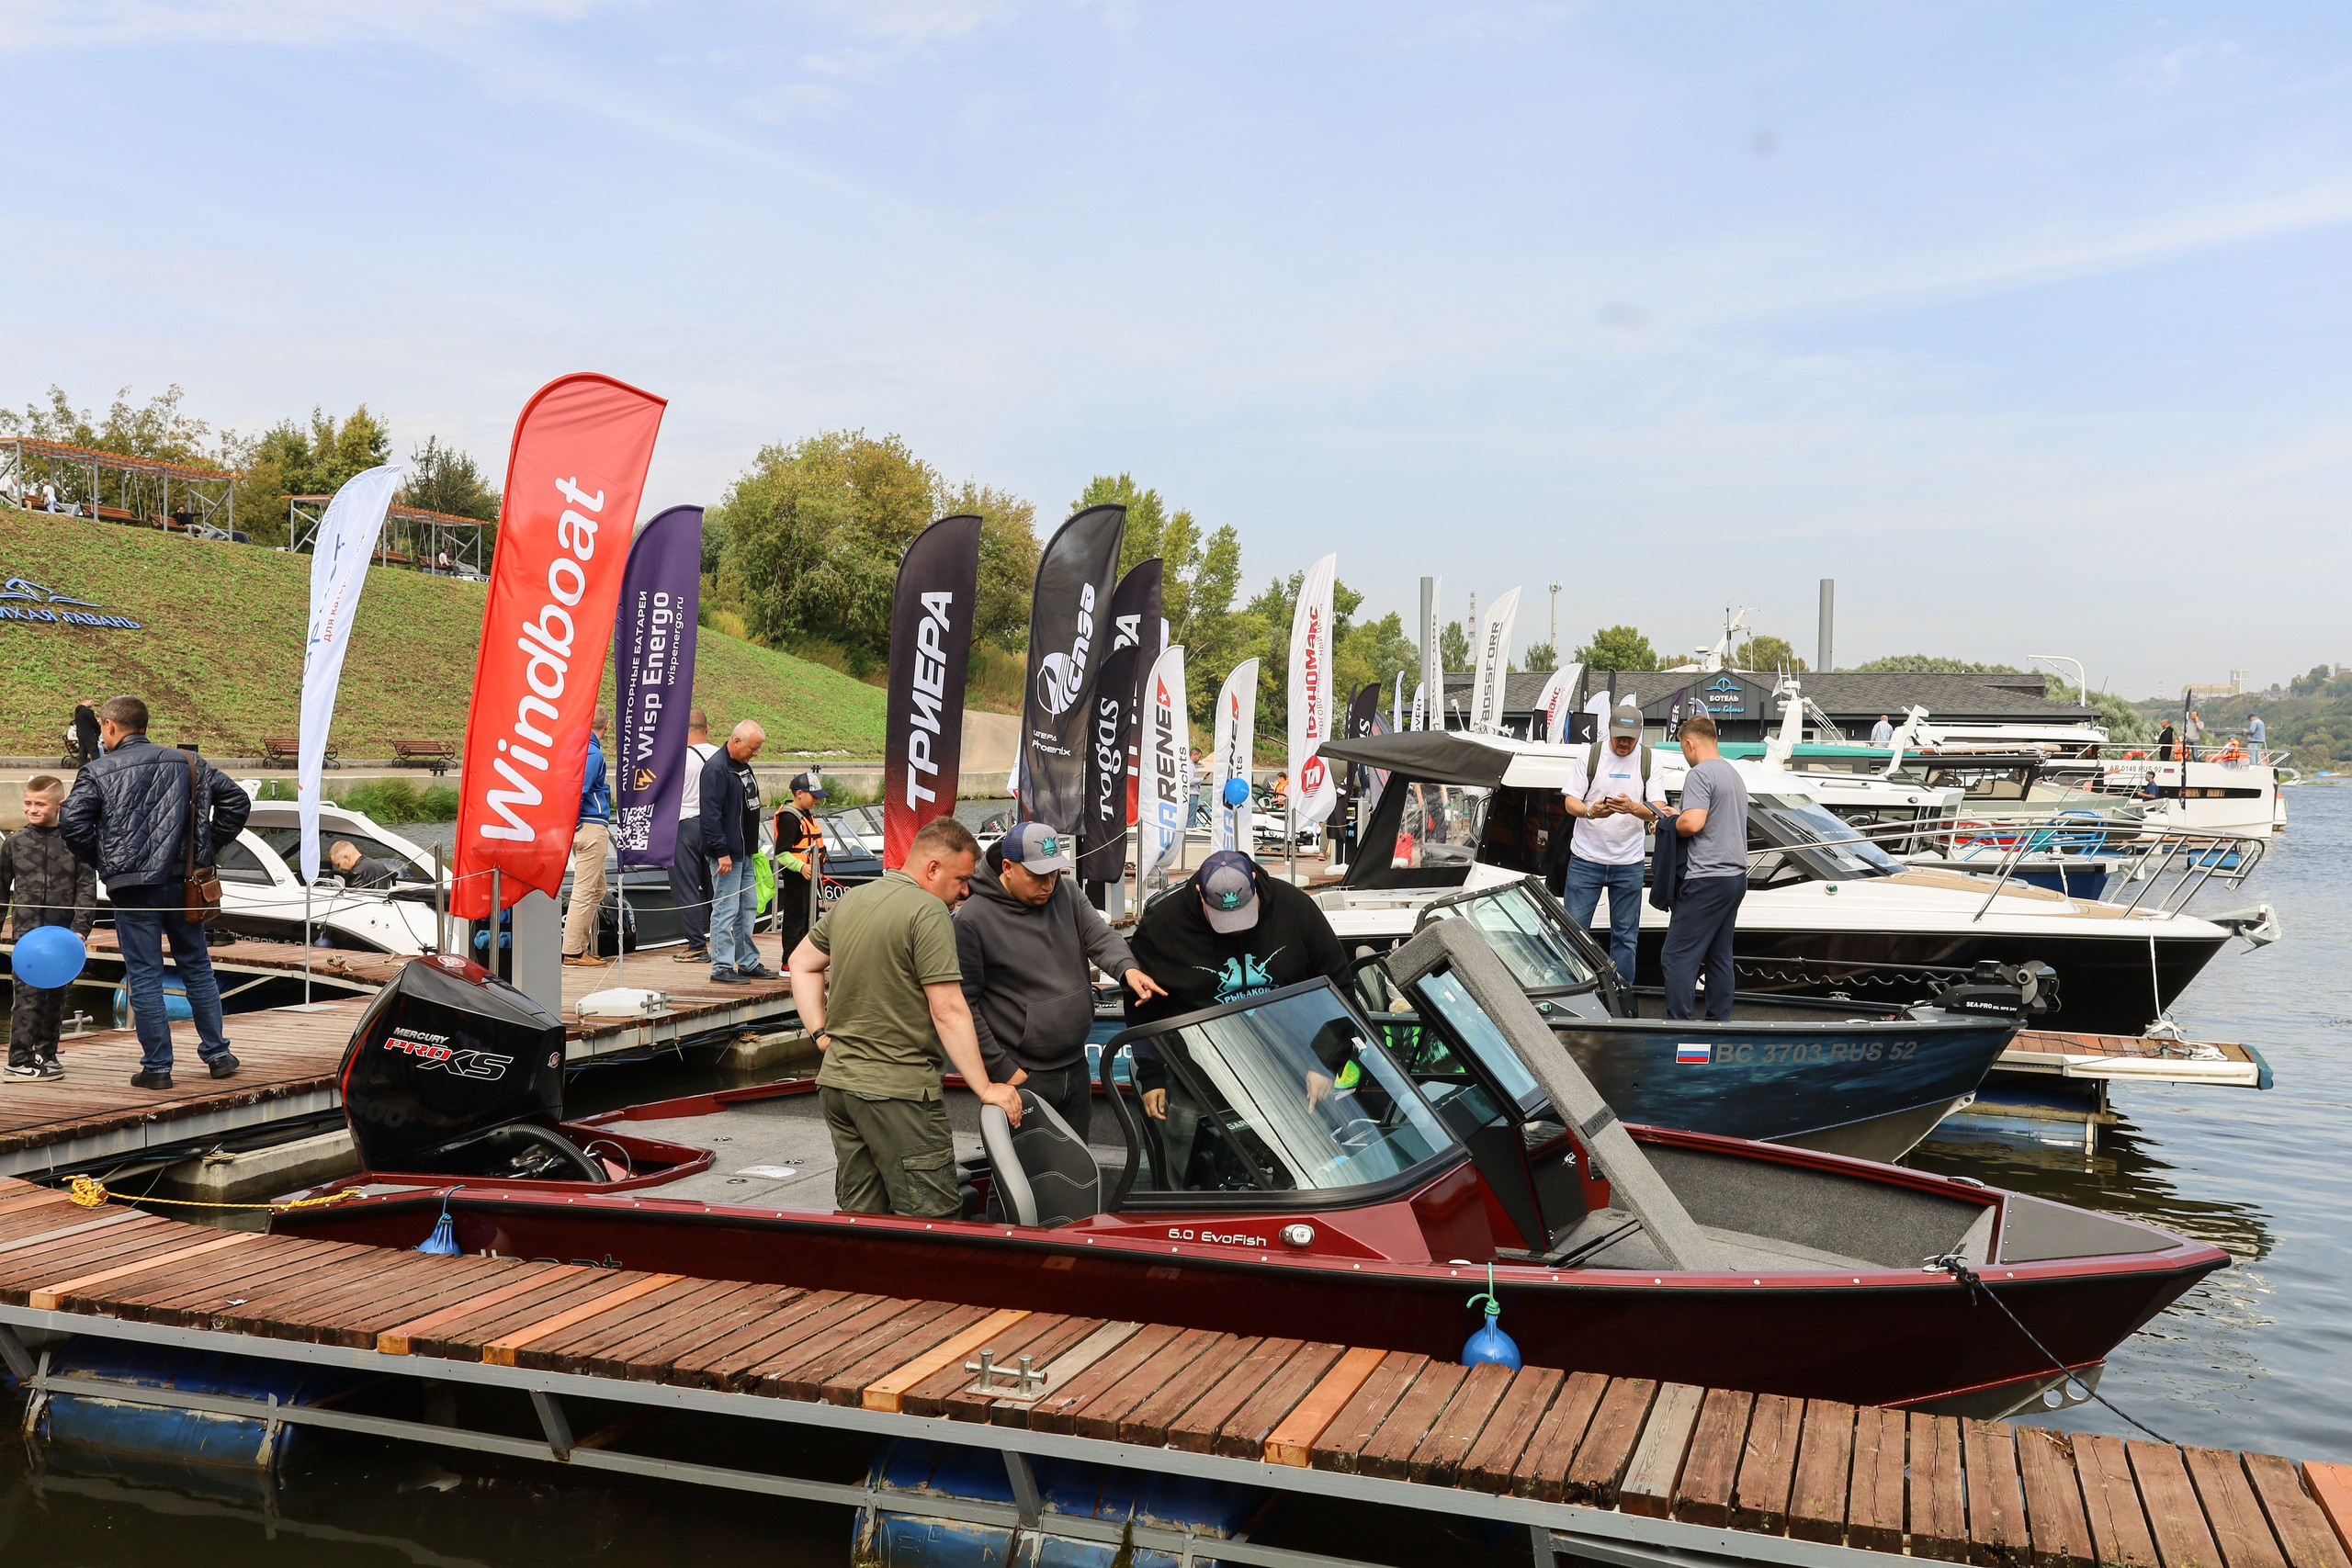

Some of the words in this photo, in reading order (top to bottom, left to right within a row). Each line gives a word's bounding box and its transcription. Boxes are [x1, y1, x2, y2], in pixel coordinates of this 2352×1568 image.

[0, 606, 59, 622] ИХАЯ
[61, 611, 141, 629] ГАВАНЬ
[642, 592, 673, 685] Energo
[668, 596, 684, 686] wispenergo.ru
[480, 476, 605, 842] Windboat
[1481, 621, 1500, 722] BOSSFORR
[906, 592, 953, 812] ТРИЕРА
[637, 693, 662, 761] Wisp
[1966, 1001, 1993, 1010] SEA-PRO
[383, 1037, 453, 1061] PRO
[393, 1026, 450, 1044] MERCURY
[1762, 1043, 1823, 1064] 3703
[1829, 1042, 1884, 1063] RUS
[1889, 1041, 1918, 1061] 52
[416, 1043, 514, 1081] XS
[1168, 1228, 1194, 1240] 6.0
[1201, 1231, 1267, 1247] EvoFish
